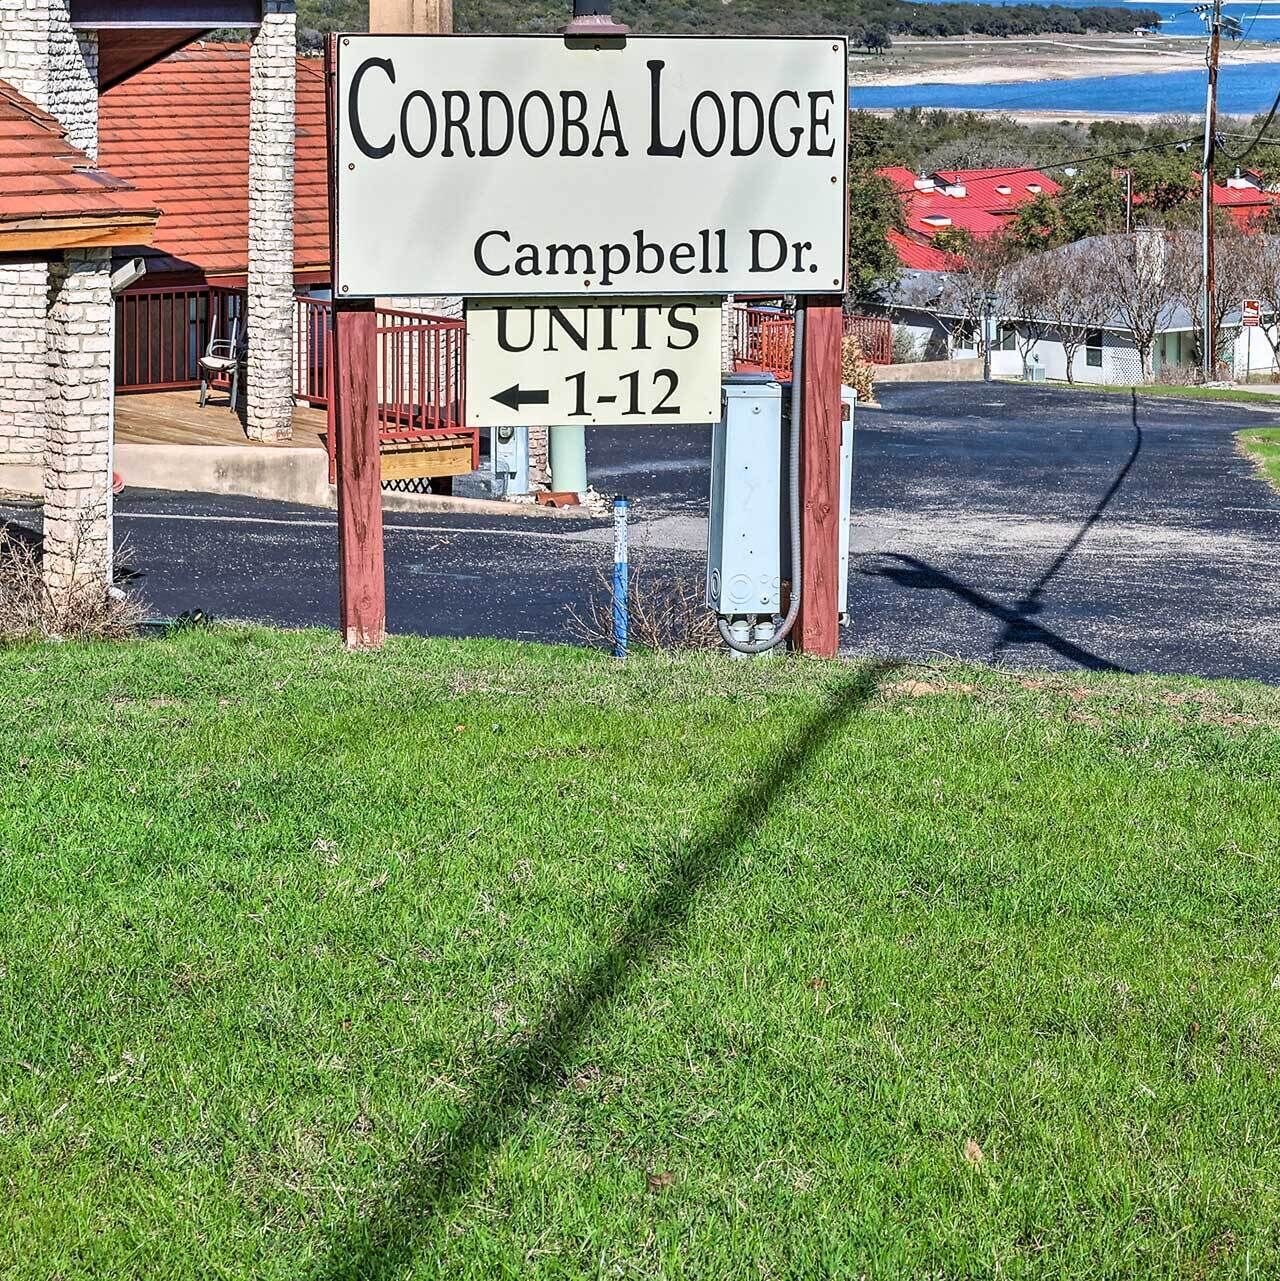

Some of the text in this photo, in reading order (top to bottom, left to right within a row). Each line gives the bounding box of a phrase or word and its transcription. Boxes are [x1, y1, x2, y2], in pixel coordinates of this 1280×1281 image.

[348, 56, 836, 160] CORDOBA LODGE
[473, 228, 819, 286] Campbell Dr.
[492, 302, 700, 353] UNITS
[564, 368, 682, 417] 1-12
